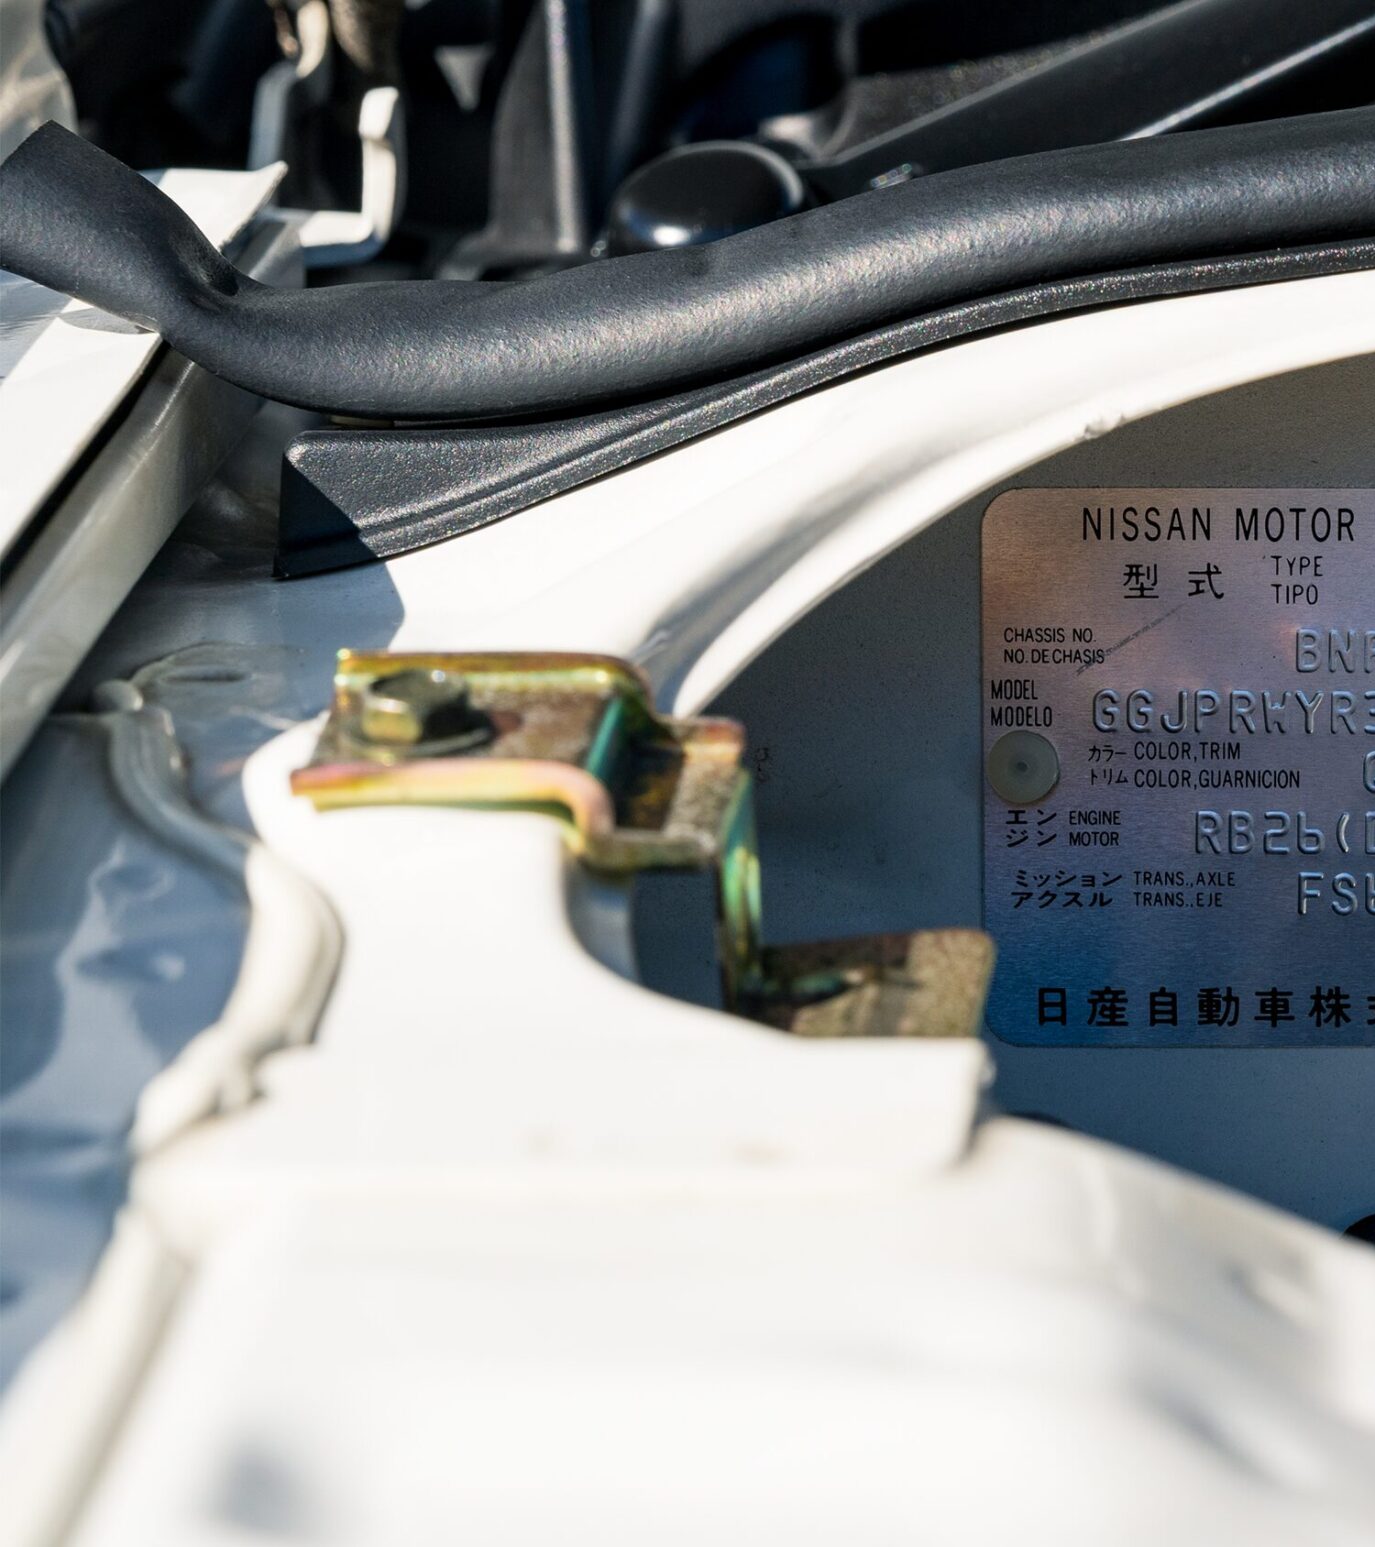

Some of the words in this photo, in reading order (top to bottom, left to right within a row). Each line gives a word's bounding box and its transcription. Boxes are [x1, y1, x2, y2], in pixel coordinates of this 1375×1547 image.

[1082, 506, 1212, 542] NISSAN
[1235, 506, 1357, 542] MOTOR
[1271, 555, 1323, 577] TYPE
[1123, 563, 1224, 600] 型式
[1271, 584, 1319, 605] TIPO
[1003, 628, 1065, 643] CHASSIS
[1072, 628, 1097, 643] NO.
[990, 680, 1038, 701] MODEL
[990, 706, 1053, 728] MODELO
[1087, 745, 1127, 762] カラー
[1134, 742, 1241, 763] COLOR,TRIM
[1090, 769, 1128, 786] トリム
[1134, 769, 1300, 791] COLOR,GUARNICION
[1005, 810, 1058, 826] エン
[1069, 811, 1121, 826] ENGINE
[1005, 829, 1058, 848] ジン
[1069, 832, 1120, 847] MOTOR
[1015, 870, 1123, 888] ミッション
[1011, 891, 1113, 909] アクスル
